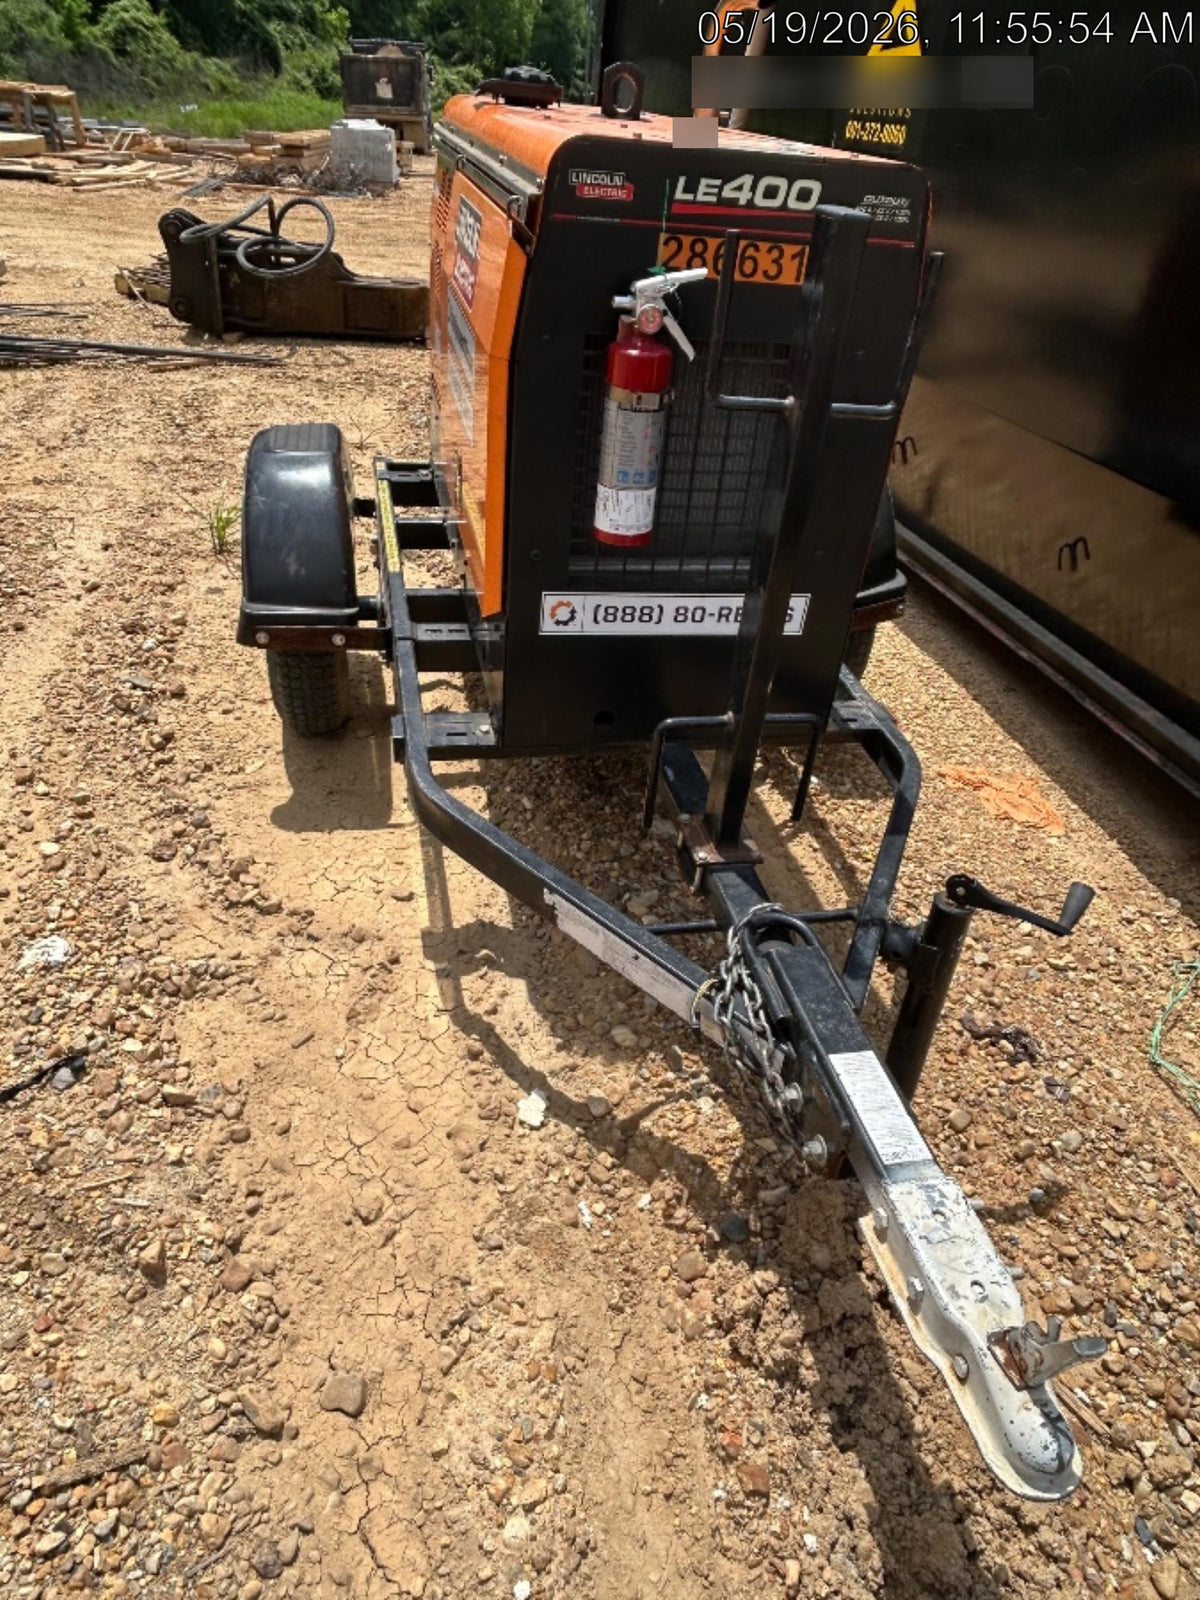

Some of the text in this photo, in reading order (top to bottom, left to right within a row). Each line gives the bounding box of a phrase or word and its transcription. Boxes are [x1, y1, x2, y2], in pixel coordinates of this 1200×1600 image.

[571, 172, 624, 186] LINCOLN
[583, 186, 628, 198] ELECTRIC
[674, 173, 822, 211] LE400
[592, 604, 665, 624] (888)
